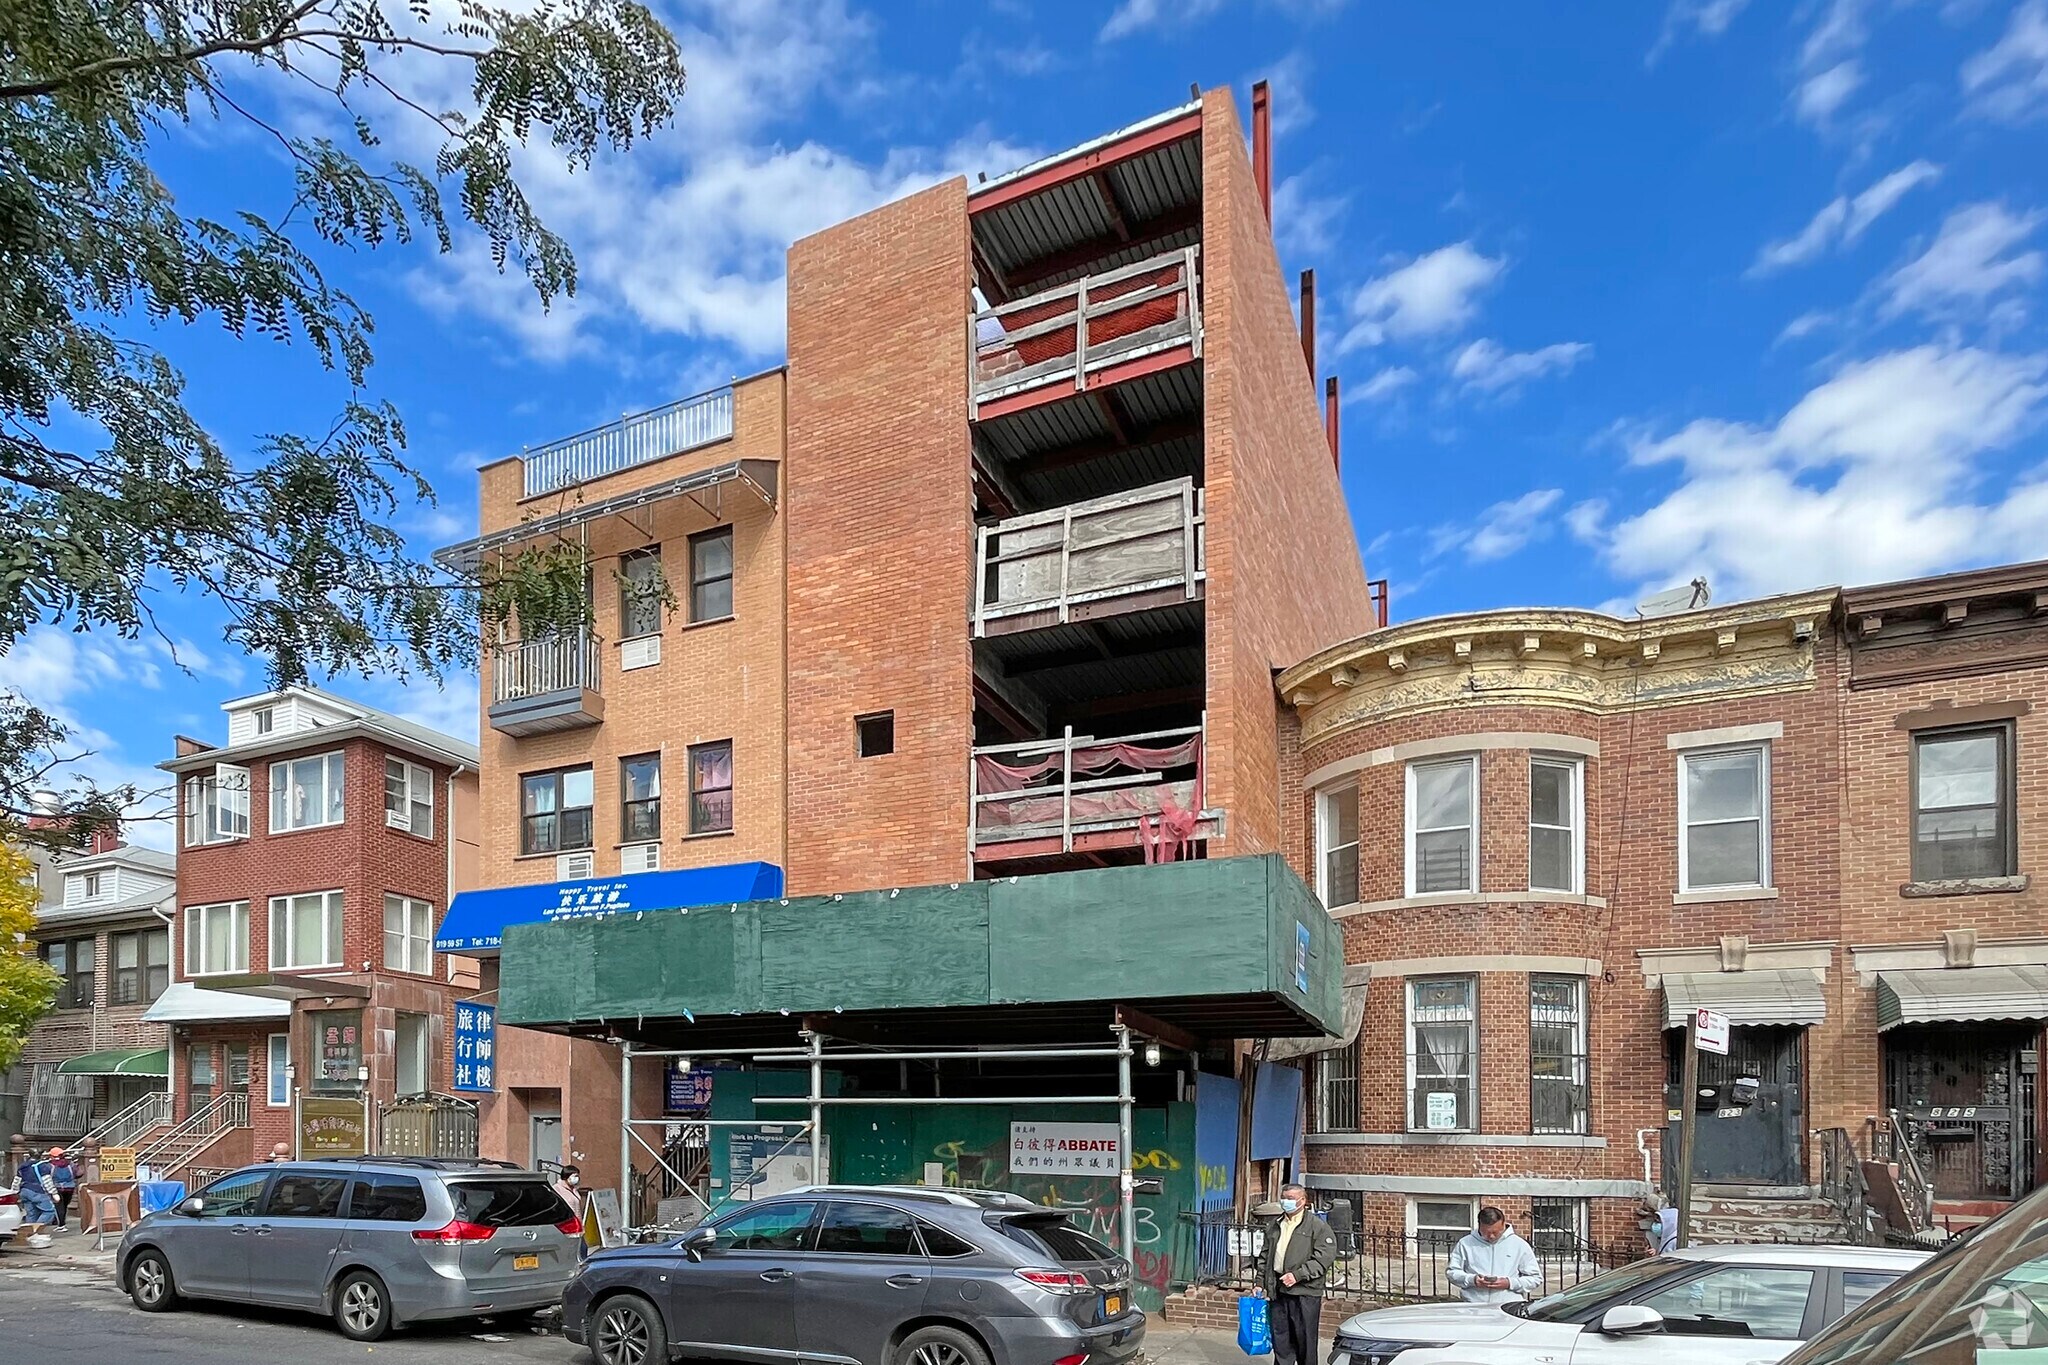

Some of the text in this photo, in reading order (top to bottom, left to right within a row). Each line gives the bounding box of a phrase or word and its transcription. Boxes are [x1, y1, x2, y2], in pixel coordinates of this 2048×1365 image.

[587, 884, 610, 892] Travel
[436, 940, 447, 948] 819
[455, 938, 464, 947] ST
[456, 1008, 473, 1085] 旅行社
[475, 1011, 491, 1087] 律師樓
[1721, 1109, 1740, 1117] 823
[1014, 1138, 1117, 1152] 白彼得 ABBATE
